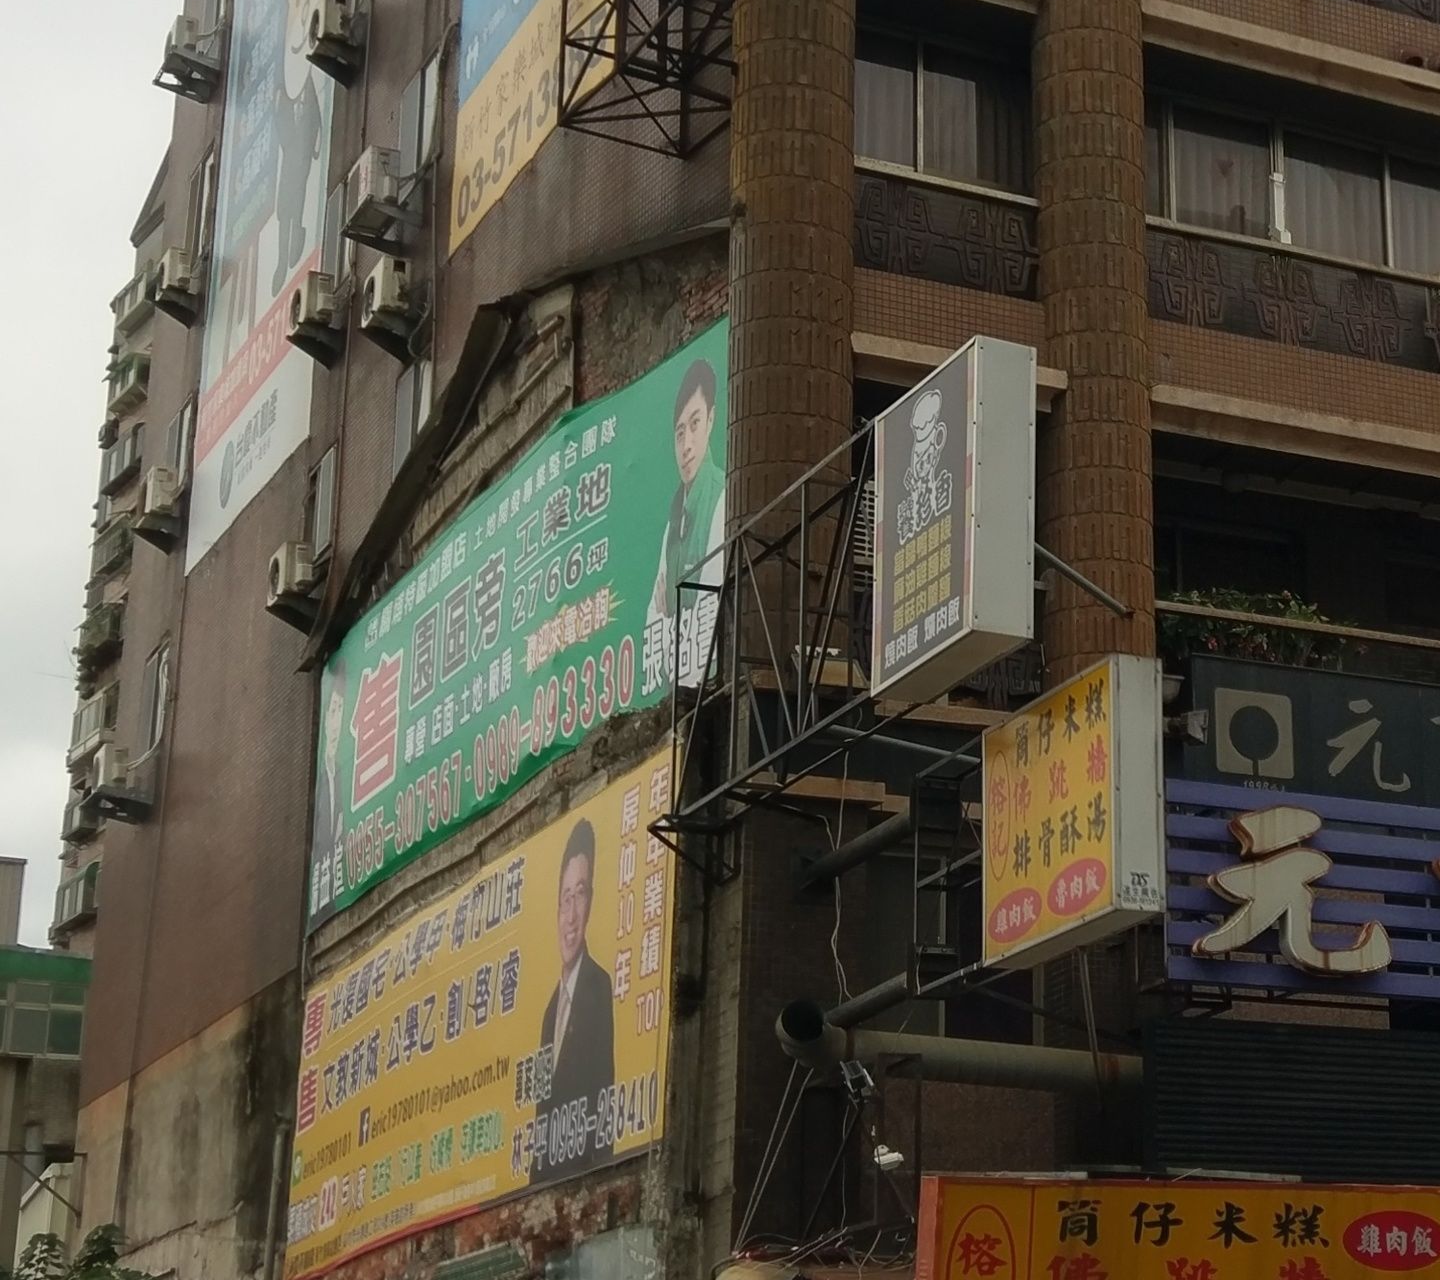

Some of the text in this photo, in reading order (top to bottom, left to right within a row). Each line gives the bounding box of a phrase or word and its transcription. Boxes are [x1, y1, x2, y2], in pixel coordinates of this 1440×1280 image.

[409, 463, 613, 710] 園區旁 工業地
[511, 536, 610, 630] 2766坪
[350, 650, 404, 812] 售
[1015, 678, 1107, 769] 筒仔米糕
[1013, 734, 1107, 823] 佛跳牆
[1013, 791, 1107, 879] 排骨酥湯
[1056, 1199, 1331, 1250] 筒仔米糕
[1357, 1224, 1438, 1257] 雞肉飯
